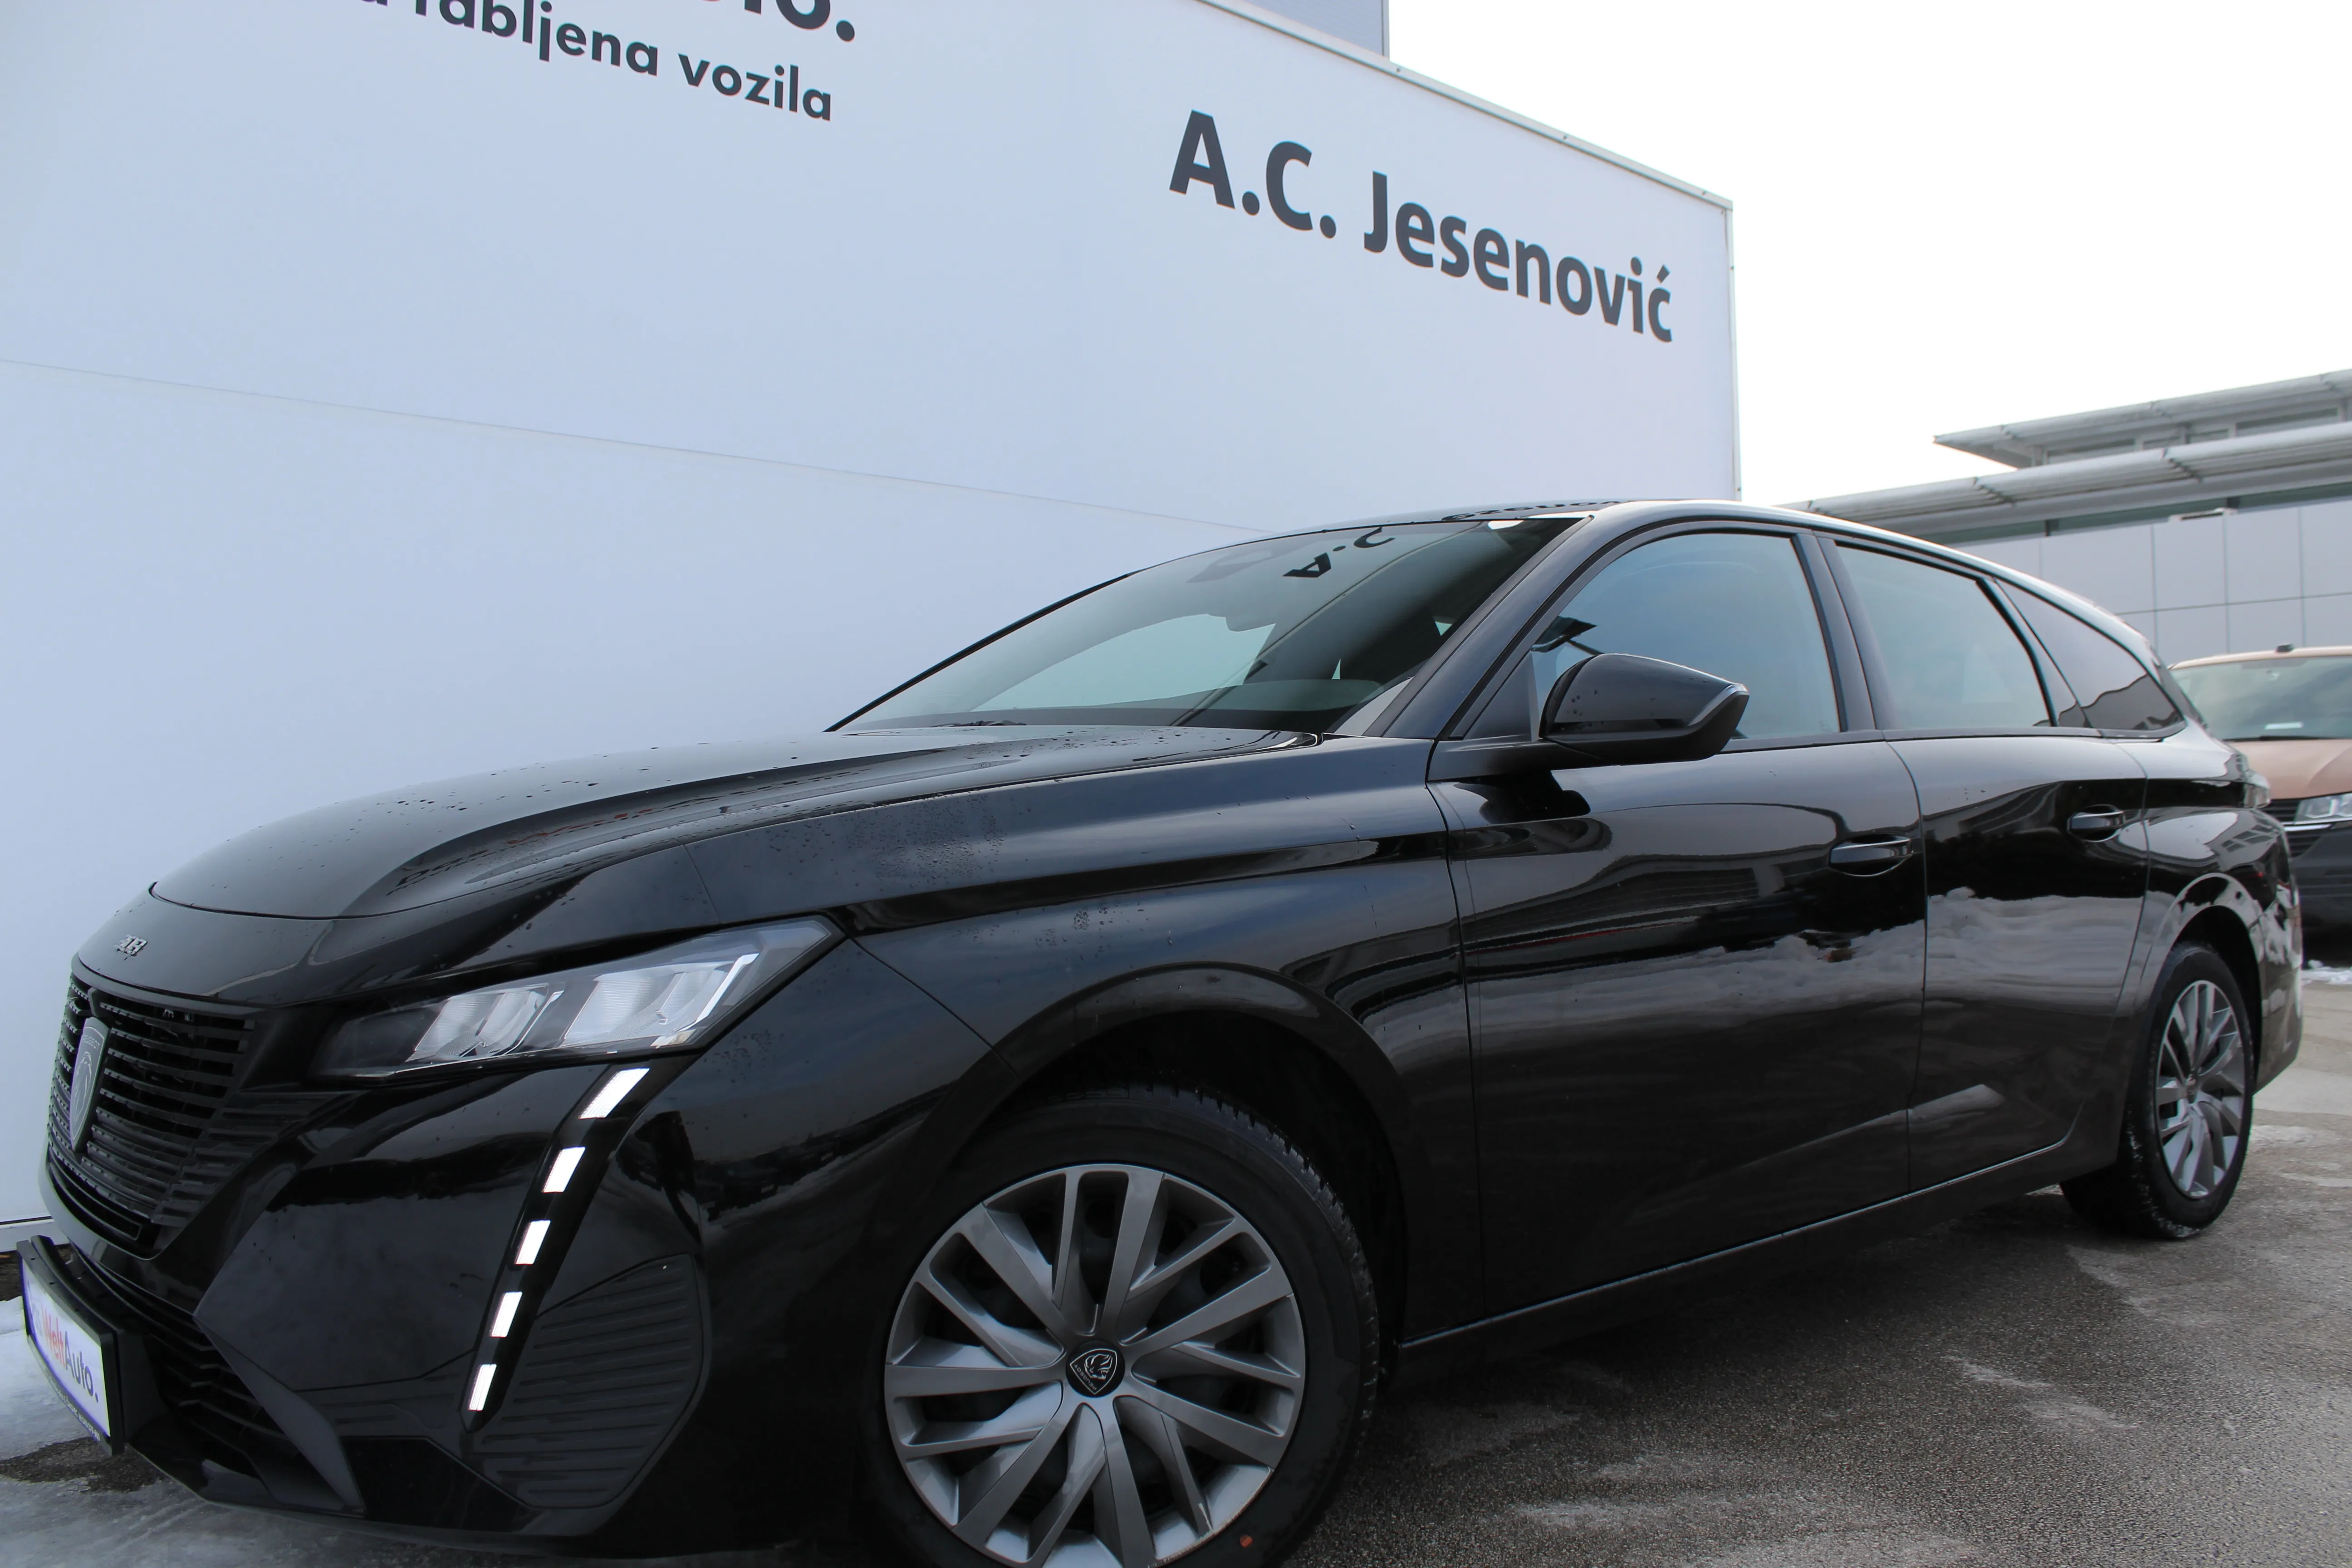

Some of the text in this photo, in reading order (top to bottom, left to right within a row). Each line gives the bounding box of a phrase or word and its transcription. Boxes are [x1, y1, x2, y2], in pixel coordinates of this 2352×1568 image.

[678, 54, 831, 121] vozila
[1169, 110, 1672, 343] A.C. Jesenović
[1074, 1364, 1097, 1390] PEUGEOT
